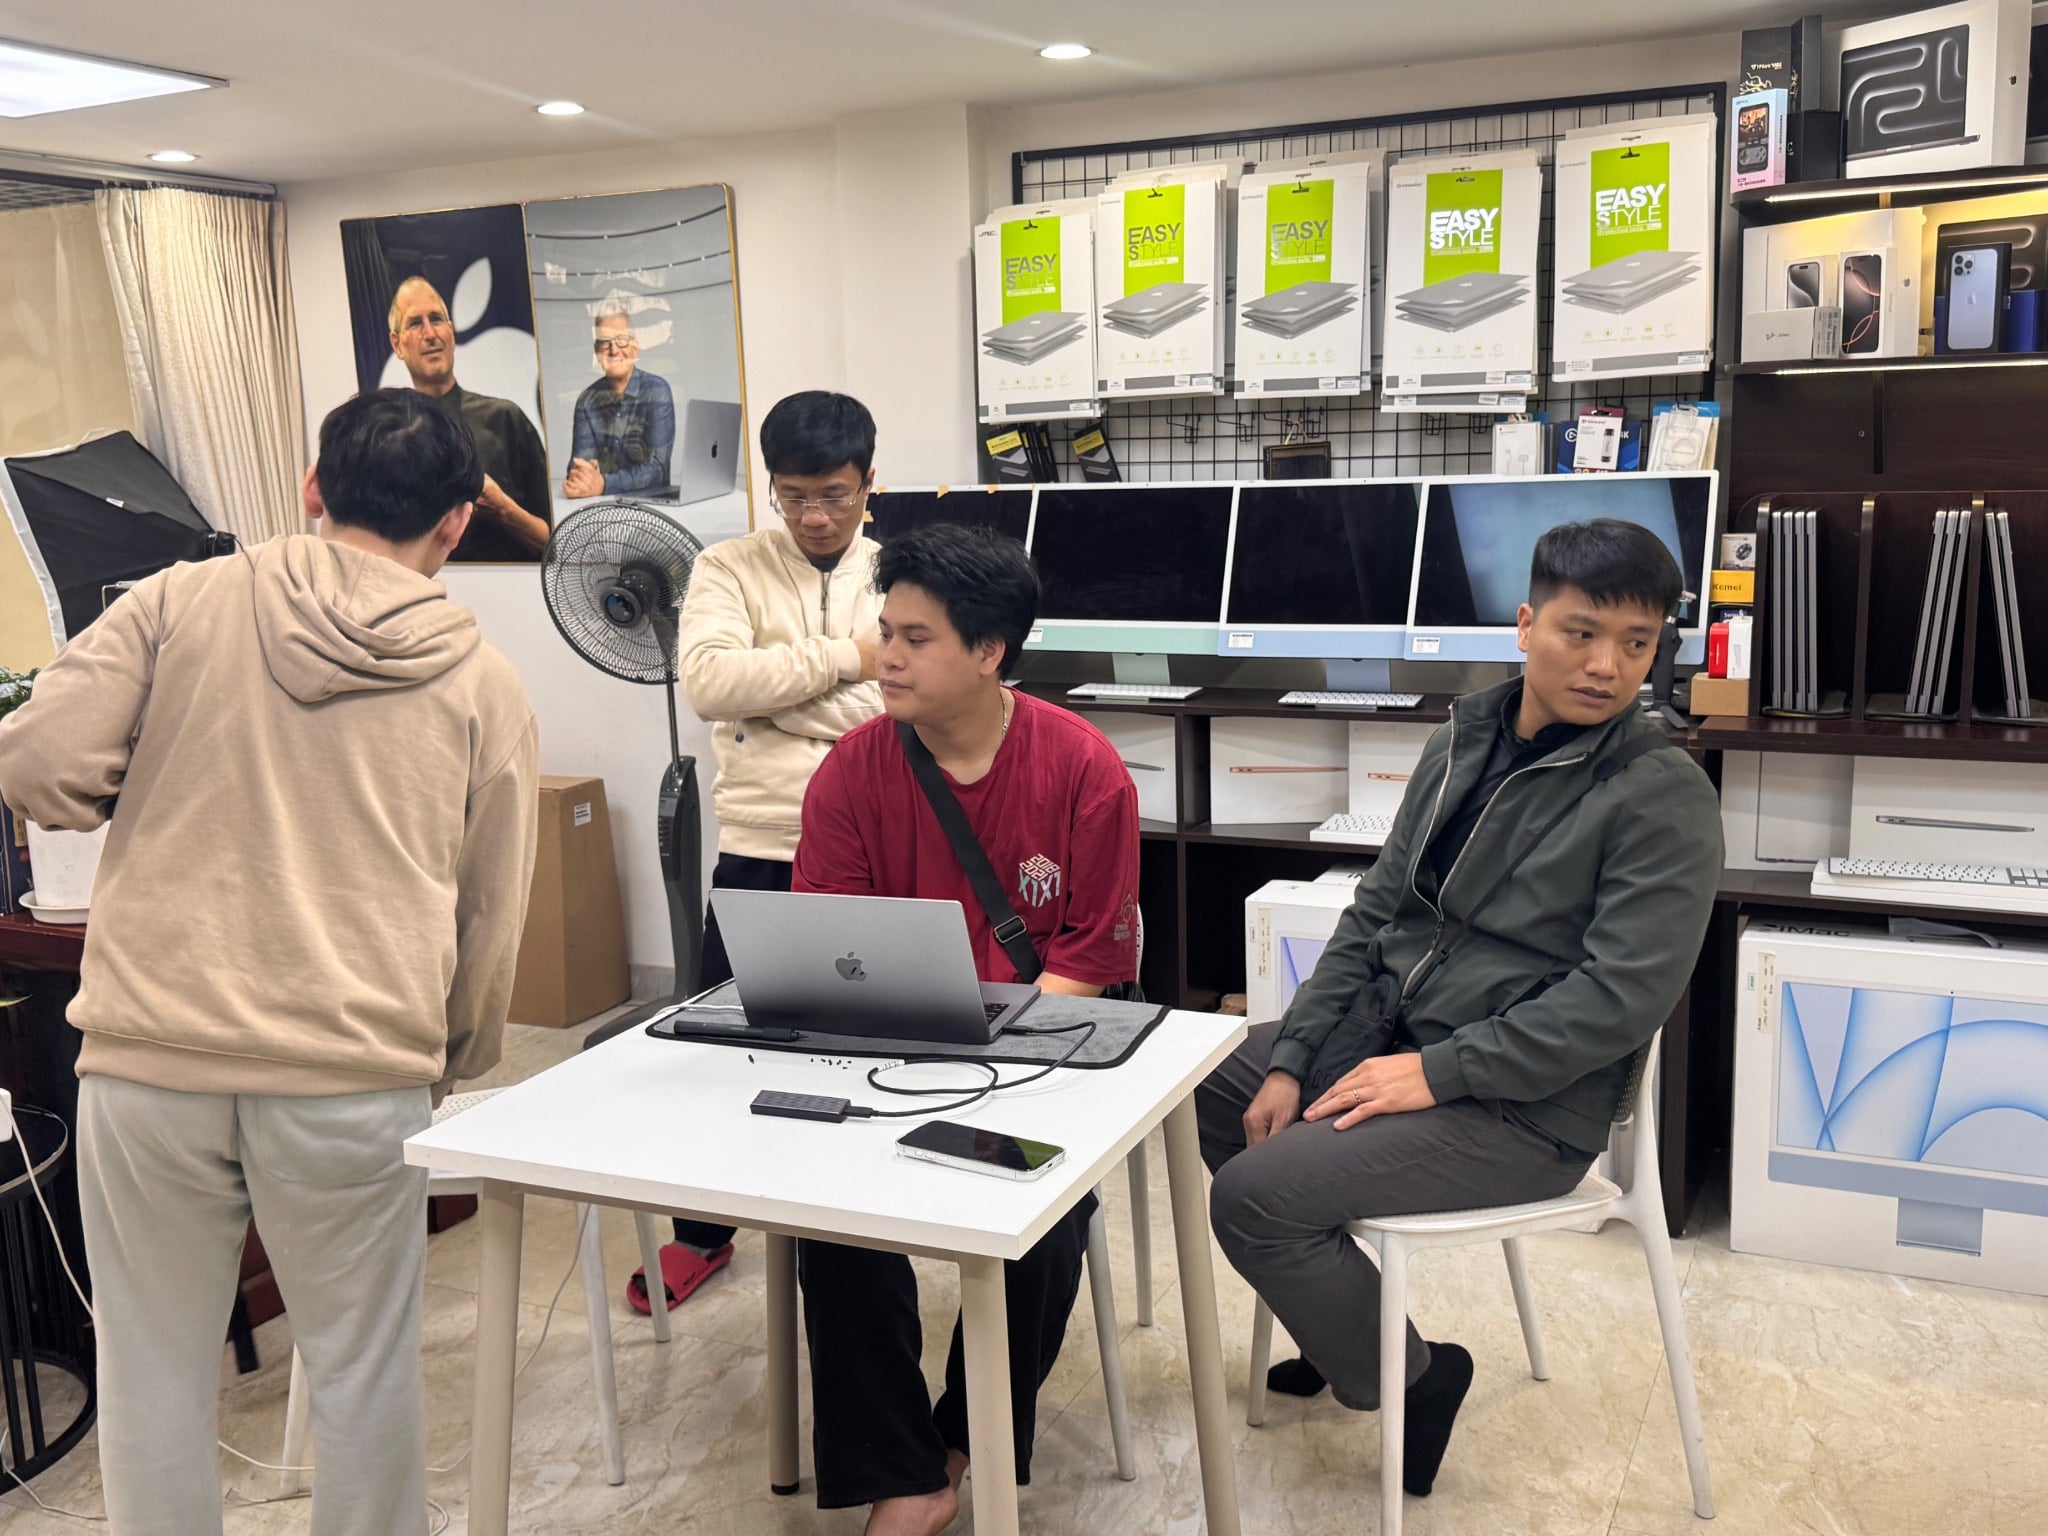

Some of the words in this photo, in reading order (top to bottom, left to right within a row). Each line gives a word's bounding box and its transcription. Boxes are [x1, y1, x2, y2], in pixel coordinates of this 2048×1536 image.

[1595, 183, 1666, 212] EASY
[1430, 207, 1499, 232] EASY
[1596, 204, 1662, 228] STYLE
[1128, 222, 1181, 245] EASY
[1271, 219, 1329, 242] EASY
[1430, 228, 1494, 250] STYLE
[1129, 241, 1178, 261] STYLE
[1270, 239, 1325, 260] STYLE
[1005, 253, 1058, 275] EASY
[1006, 272, 1054, 291] STYLE
[1019, 860, 1049, 882] 2021
[1030, 853, 1061, 874] 2018
[1779, 925, 1850, 937] iMac
